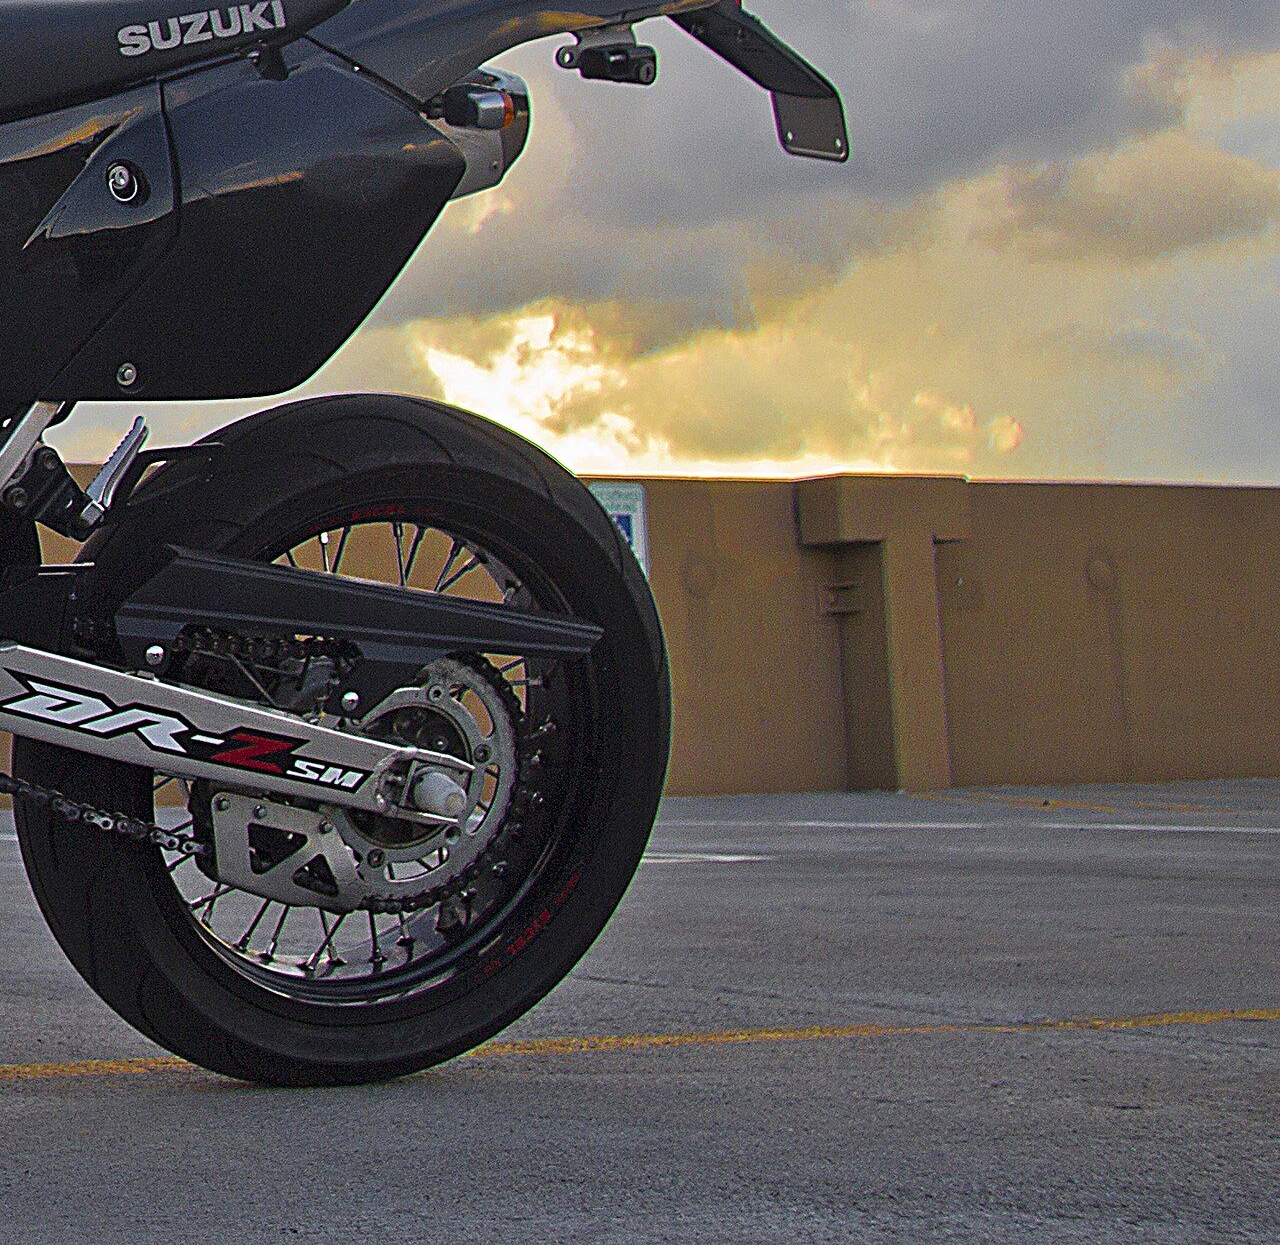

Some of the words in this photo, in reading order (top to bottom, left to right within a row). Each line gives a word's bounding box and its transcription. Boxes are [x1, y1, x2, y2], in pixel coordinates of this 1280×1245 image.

[117, 0, 286, 57] SUZUKI
[0, 679, 296, 775] DR-Z
[285, 759, 364, 788] SM
